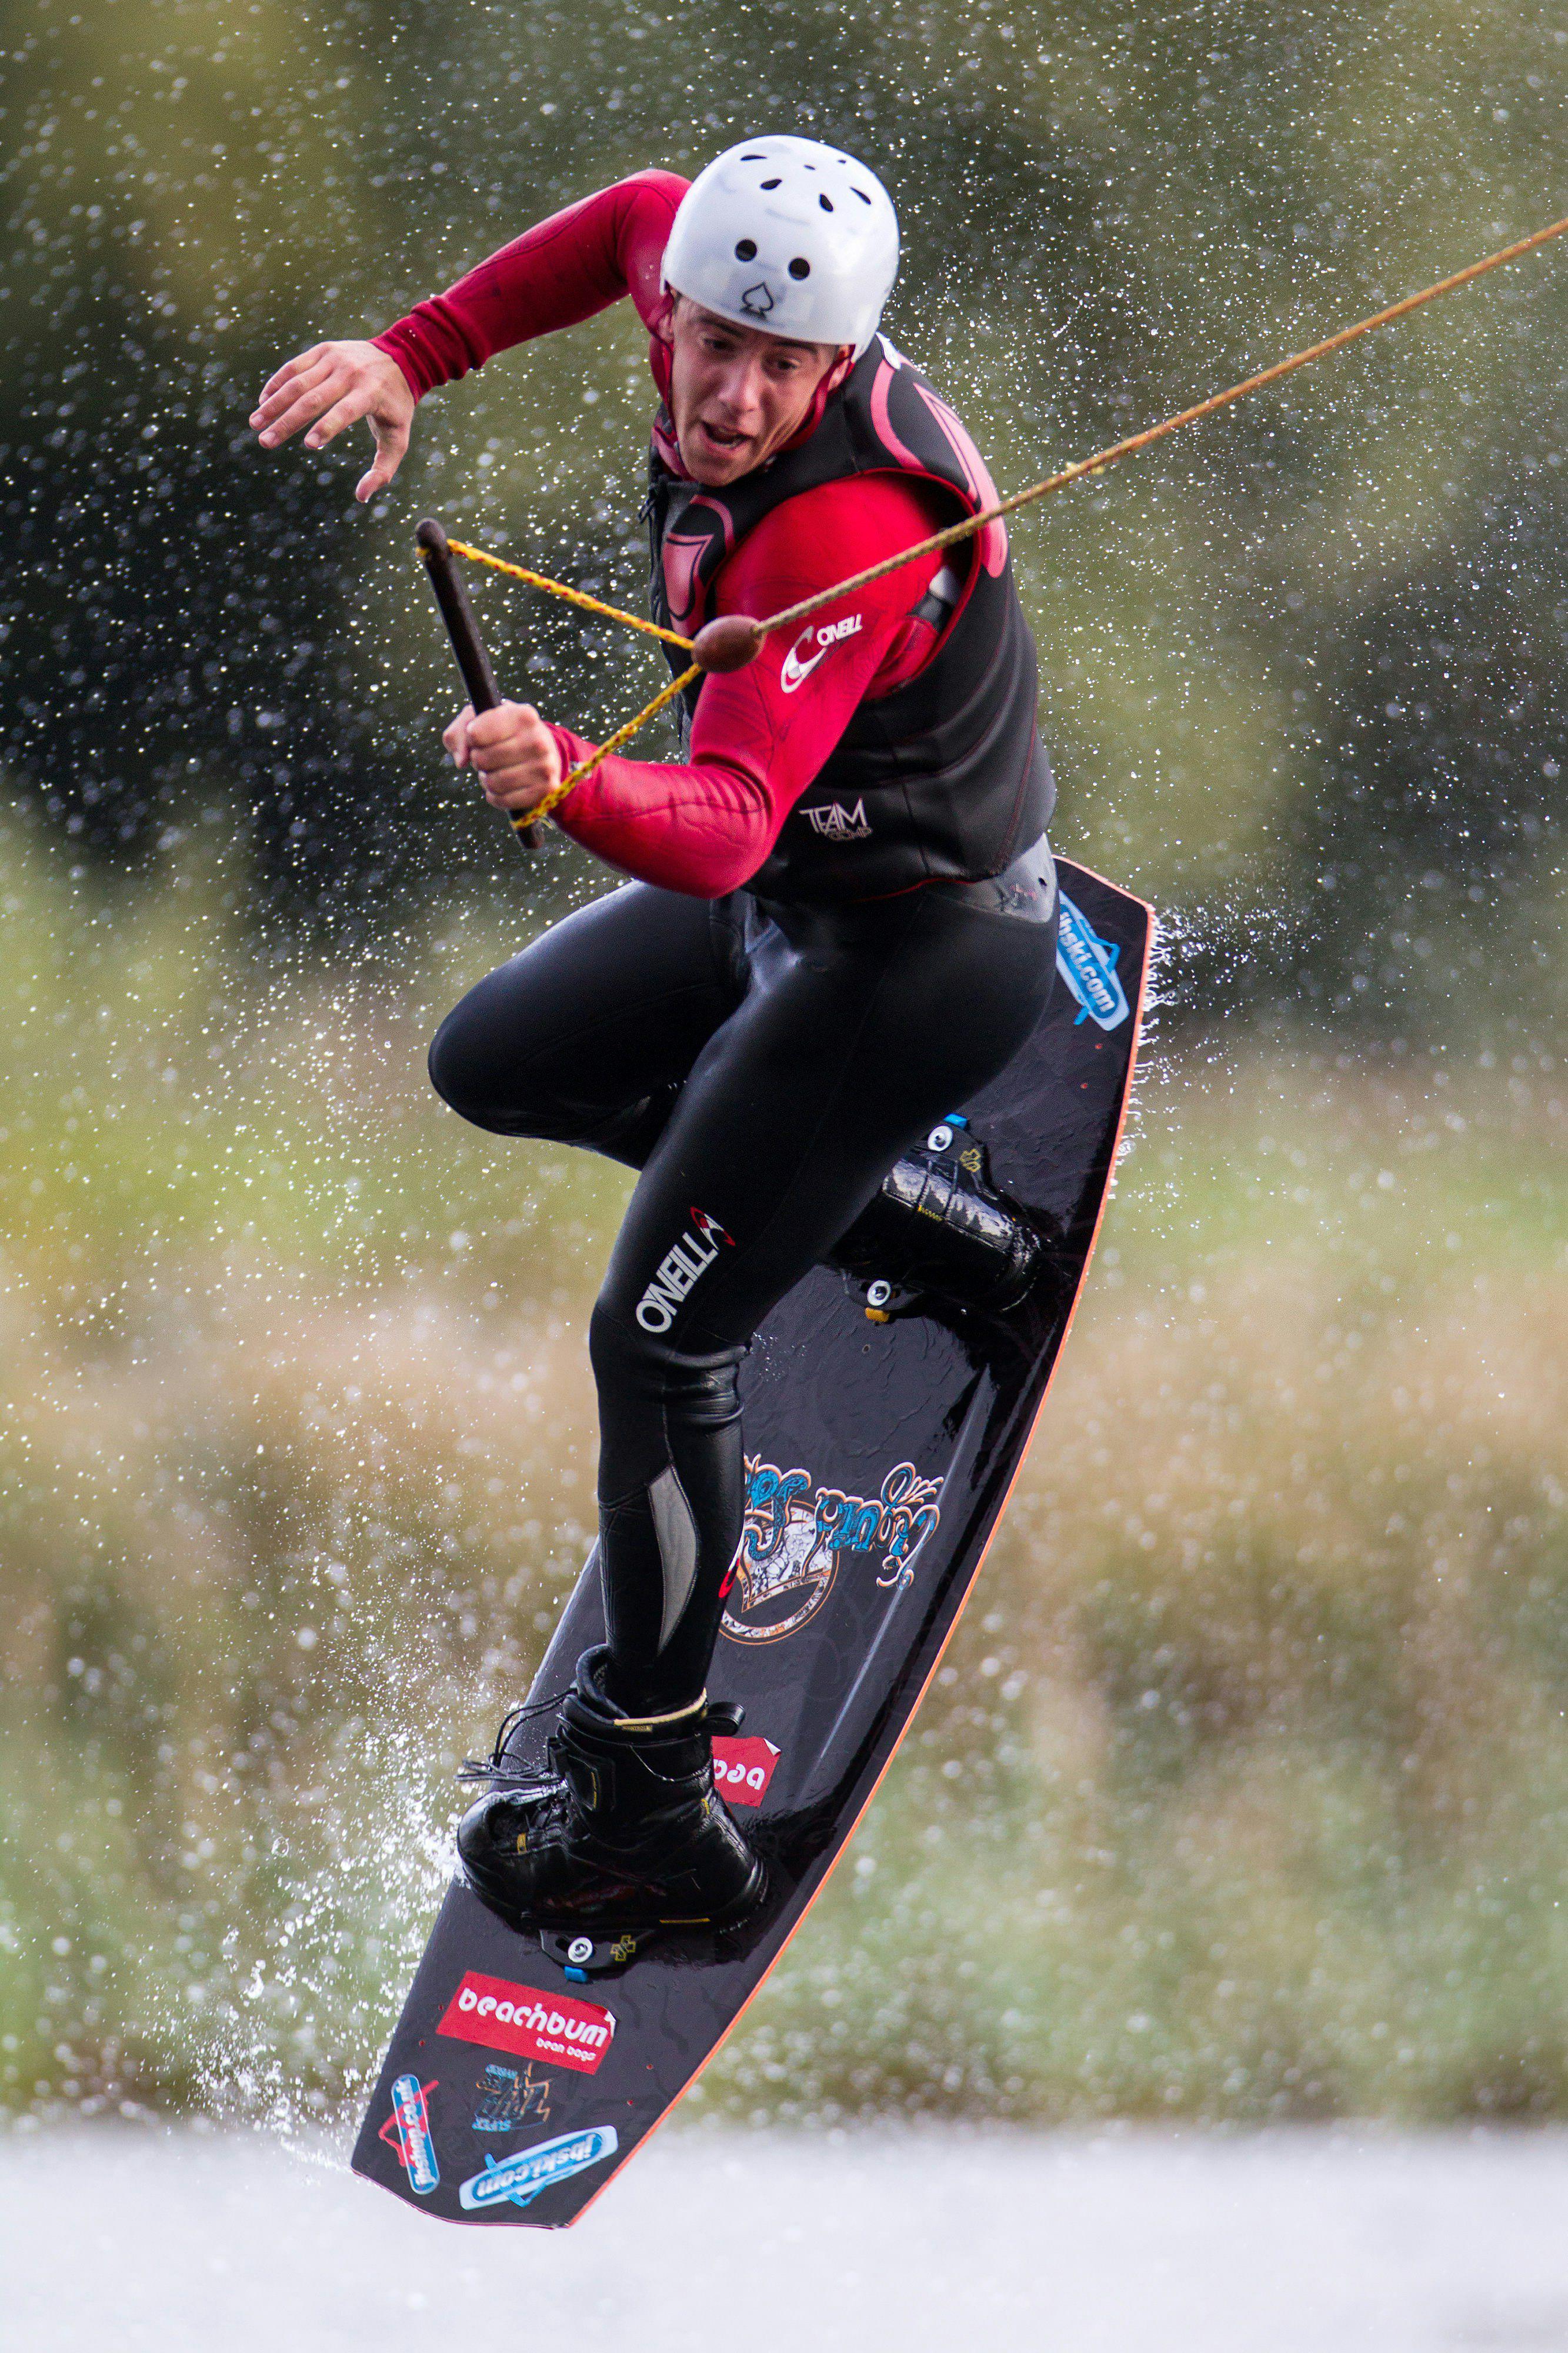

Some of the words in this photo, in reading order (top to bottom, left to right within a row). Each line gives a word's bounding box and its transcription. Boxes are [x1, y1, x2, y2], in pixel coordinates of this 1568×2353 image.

[799, 797, 868, 836] TEAM
[458, 1987, 609, 2048] beachbum
[536, 2037, 565, 2054] bean
[566, 2045, 596, 2062] bags
[476, 2133, 596, 2198] jbski.com
